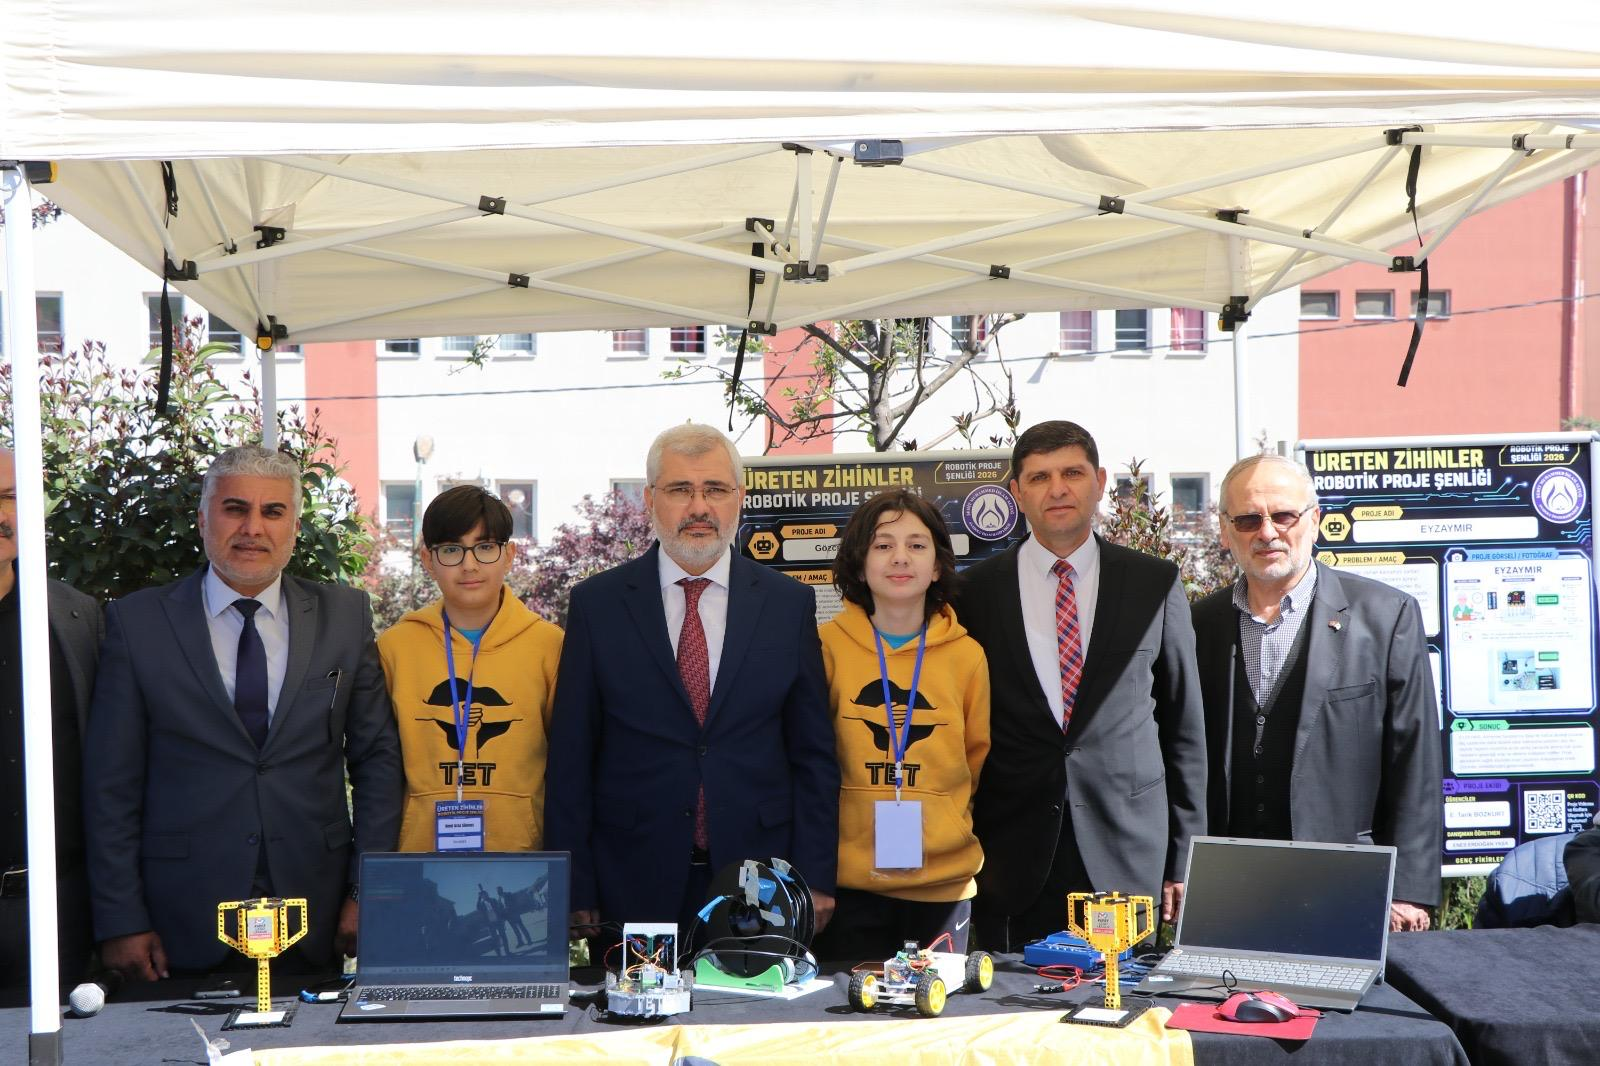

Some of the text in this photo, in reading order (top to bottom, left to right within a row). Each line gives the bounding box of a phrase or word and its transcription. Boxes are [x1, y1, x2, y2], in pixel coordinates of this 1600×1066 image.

[1510, 444, 1570, 453] ROBOTİK PROJE
[1313, 447, 1484, 472] ÜRETEN ZİHİNLER
[1511, 453, 1565, 463] ŞENLİĞİ 2026
[945, 462, 1002, 471] ROBOTİK PROJE
[743, 463, 914, 490] ÜRETEN ZİHİNLER
[945, 470, 998, 481] ŞENLİĞİ 2026
[1314, 469, 1492, 491] ROBOTİK PROJE ŞENLİĞİ
[742, 490, 807, 509] ROBOTİK
[811, 490, 860, 507] PROJE
[792, 528, 813, 536] PROJE
[1420, 523, 1473, 534] EYZAYMIR
[1343, 556, 1373, 564] PROBLEM
[1378, 555, 1397, 563] AMAÇ
[1522, 551, 1553, 559] FOTOĞRAF
[1494, 565, 1542, 575] EYZAYMIR
[808, 574, 828, 582] AMAÇ
[439, 762, 496, 786] TET
[865, 762, 921, 787] TET
[1455, 857, 1473, 865] GENÇ
